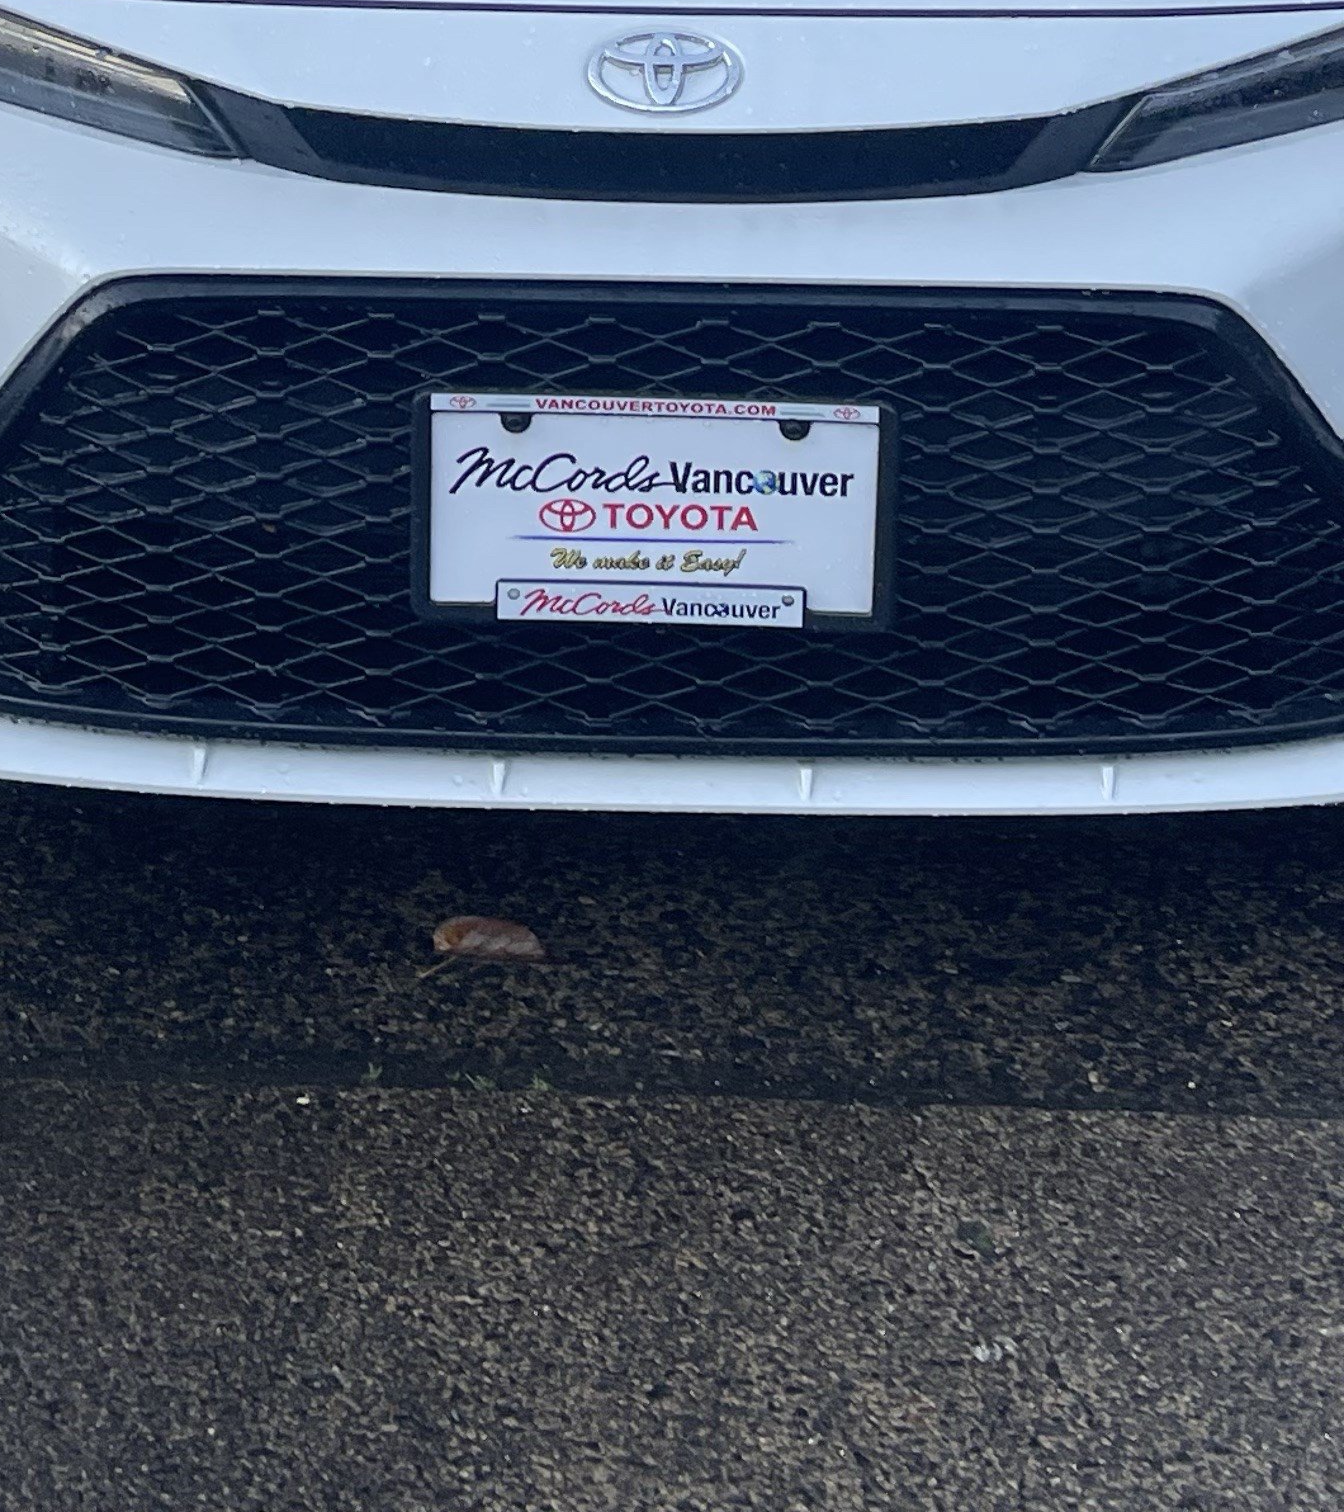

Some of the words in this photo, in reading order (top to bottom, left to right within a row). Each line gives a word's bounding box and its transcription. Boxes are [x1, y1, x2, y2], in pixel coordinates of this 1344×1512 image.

[535, 398, 777, 416] VANCOUVERTOYOTA.COM
[449, 446, 662, 495] McCords
[668, 461, 855, 498] Vancouver
[602, 503, 759, 532] TOYOTA
[550, 547, 588, 570] We
[592, 550, 650, 571] make
[655, 554, 676, 571] it
[680, 548, 747, 577] Easy!
[519, 588, 656, 617] McCords
[661, 597, 782, 620] Vancouver
